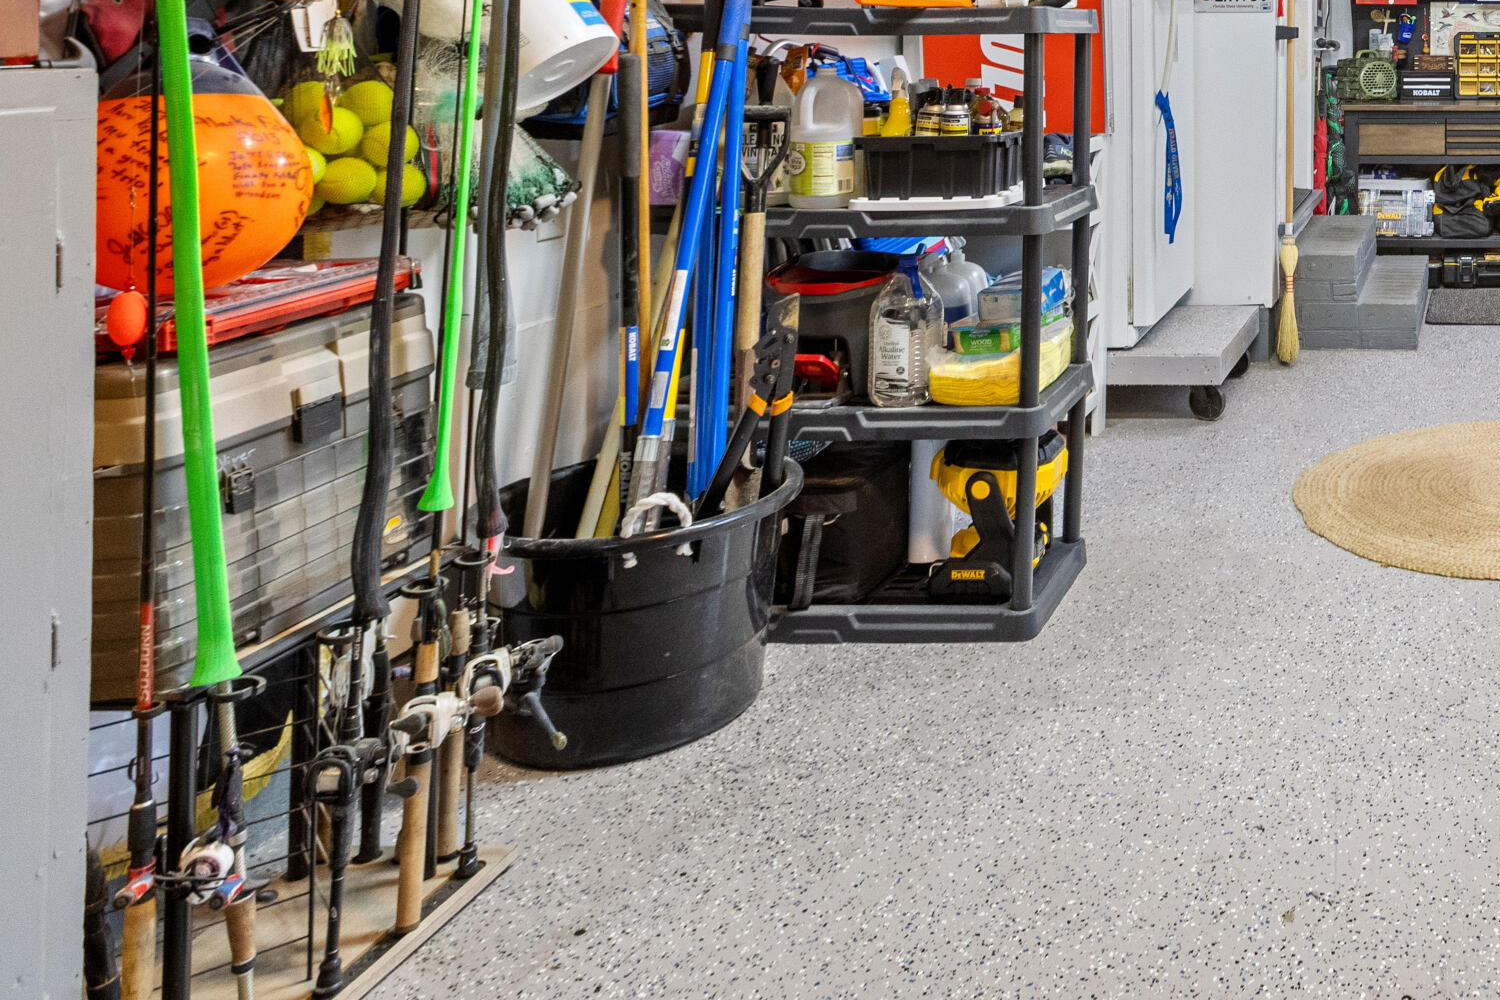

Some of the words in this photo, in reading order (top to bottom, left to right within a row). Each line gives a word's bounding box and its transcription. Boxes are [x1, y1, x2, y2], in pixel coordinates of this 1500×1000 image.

[628, 332, 637, 362] KOBALT
[951, 569, 985, 580] DEWALT
[140, 624, 151, 702] SOJOURN
